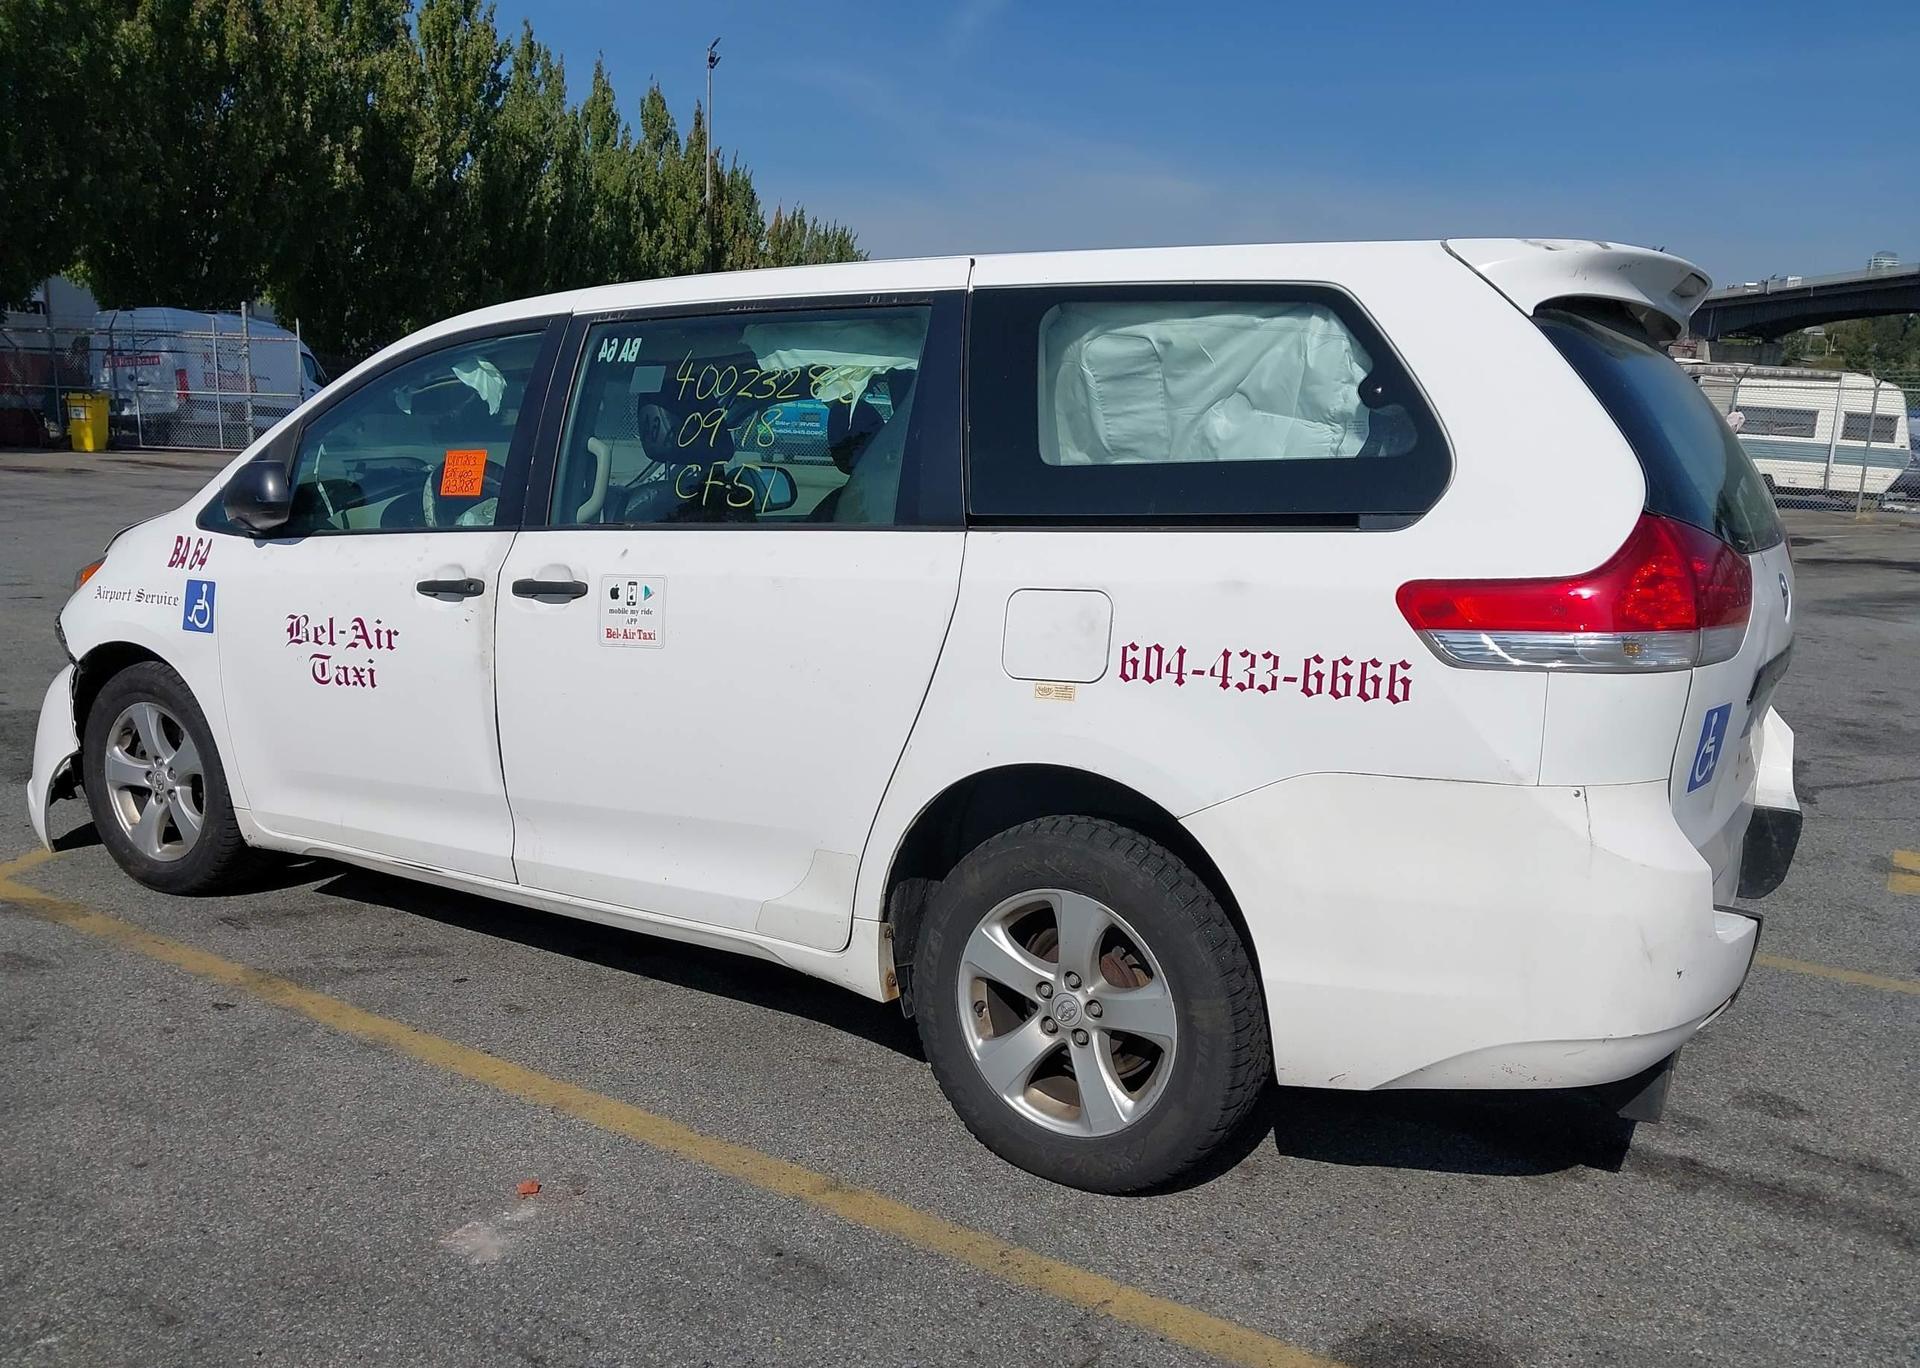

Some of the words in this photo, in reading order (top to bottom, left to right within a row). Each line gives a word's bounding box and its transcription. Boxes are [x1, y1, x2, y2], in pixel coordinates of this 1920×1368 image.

[167, 535, 192, 570] BA
[188, 537, 213, 572] 64
[94, 585, 132, 603] Airport
[134, 588, 180, 607] Service
[608, 607, 629, 615] mobile
[629, 609, 639, 617] my
[640, 608, 654, 616] ride
[285, 613, 400, 651] Bel-Air
[605, 627, 636, 640] Bel-Air
[636, 628, 657, 641] Taxi
[309, 653, 378, 689] Taxi
[1119, 641, 1413, 704] 604-433-6666
